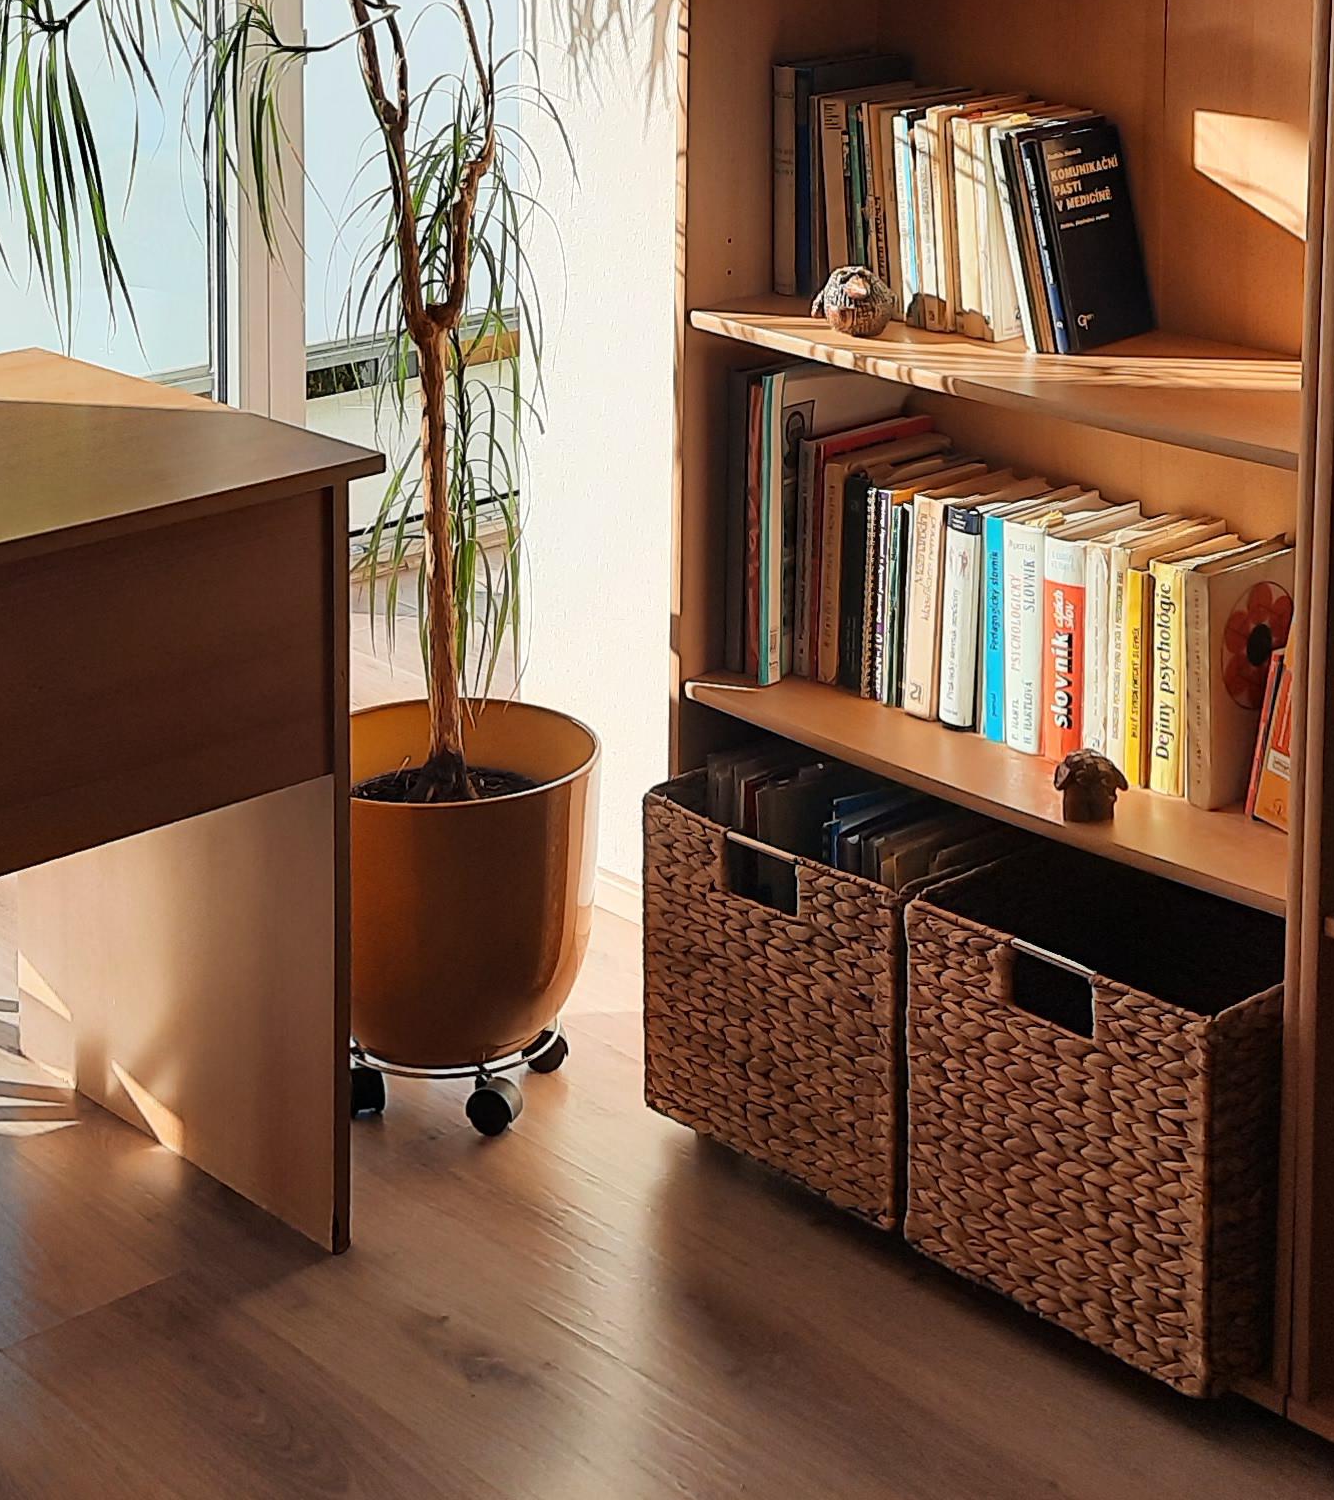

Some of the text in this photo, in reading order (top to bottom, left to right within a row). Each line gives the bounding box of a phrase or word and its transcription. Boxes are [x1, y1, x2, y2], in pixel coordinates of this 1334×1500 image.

[1050, 154, 1119, 182] KOMUNIKAČNÍ
[1053, 179, 1082, 197] PASTI
[1055, 185, 1113, 213] V MEDICÍNĚ
[989, 551, 999, 587] slovník
[1020, 558, 1036, 613] SLOVNÍK
[989, 588, 1001, 651] Pedagogický
[1008, 574, 1022, 672] PSYCHOLOGICKÝ
[1065, 601, 1076, 630] slov
[1050, 630, 1073, 729] slovník
[1155, 582, 1176, 761] Dejiny psychológie
